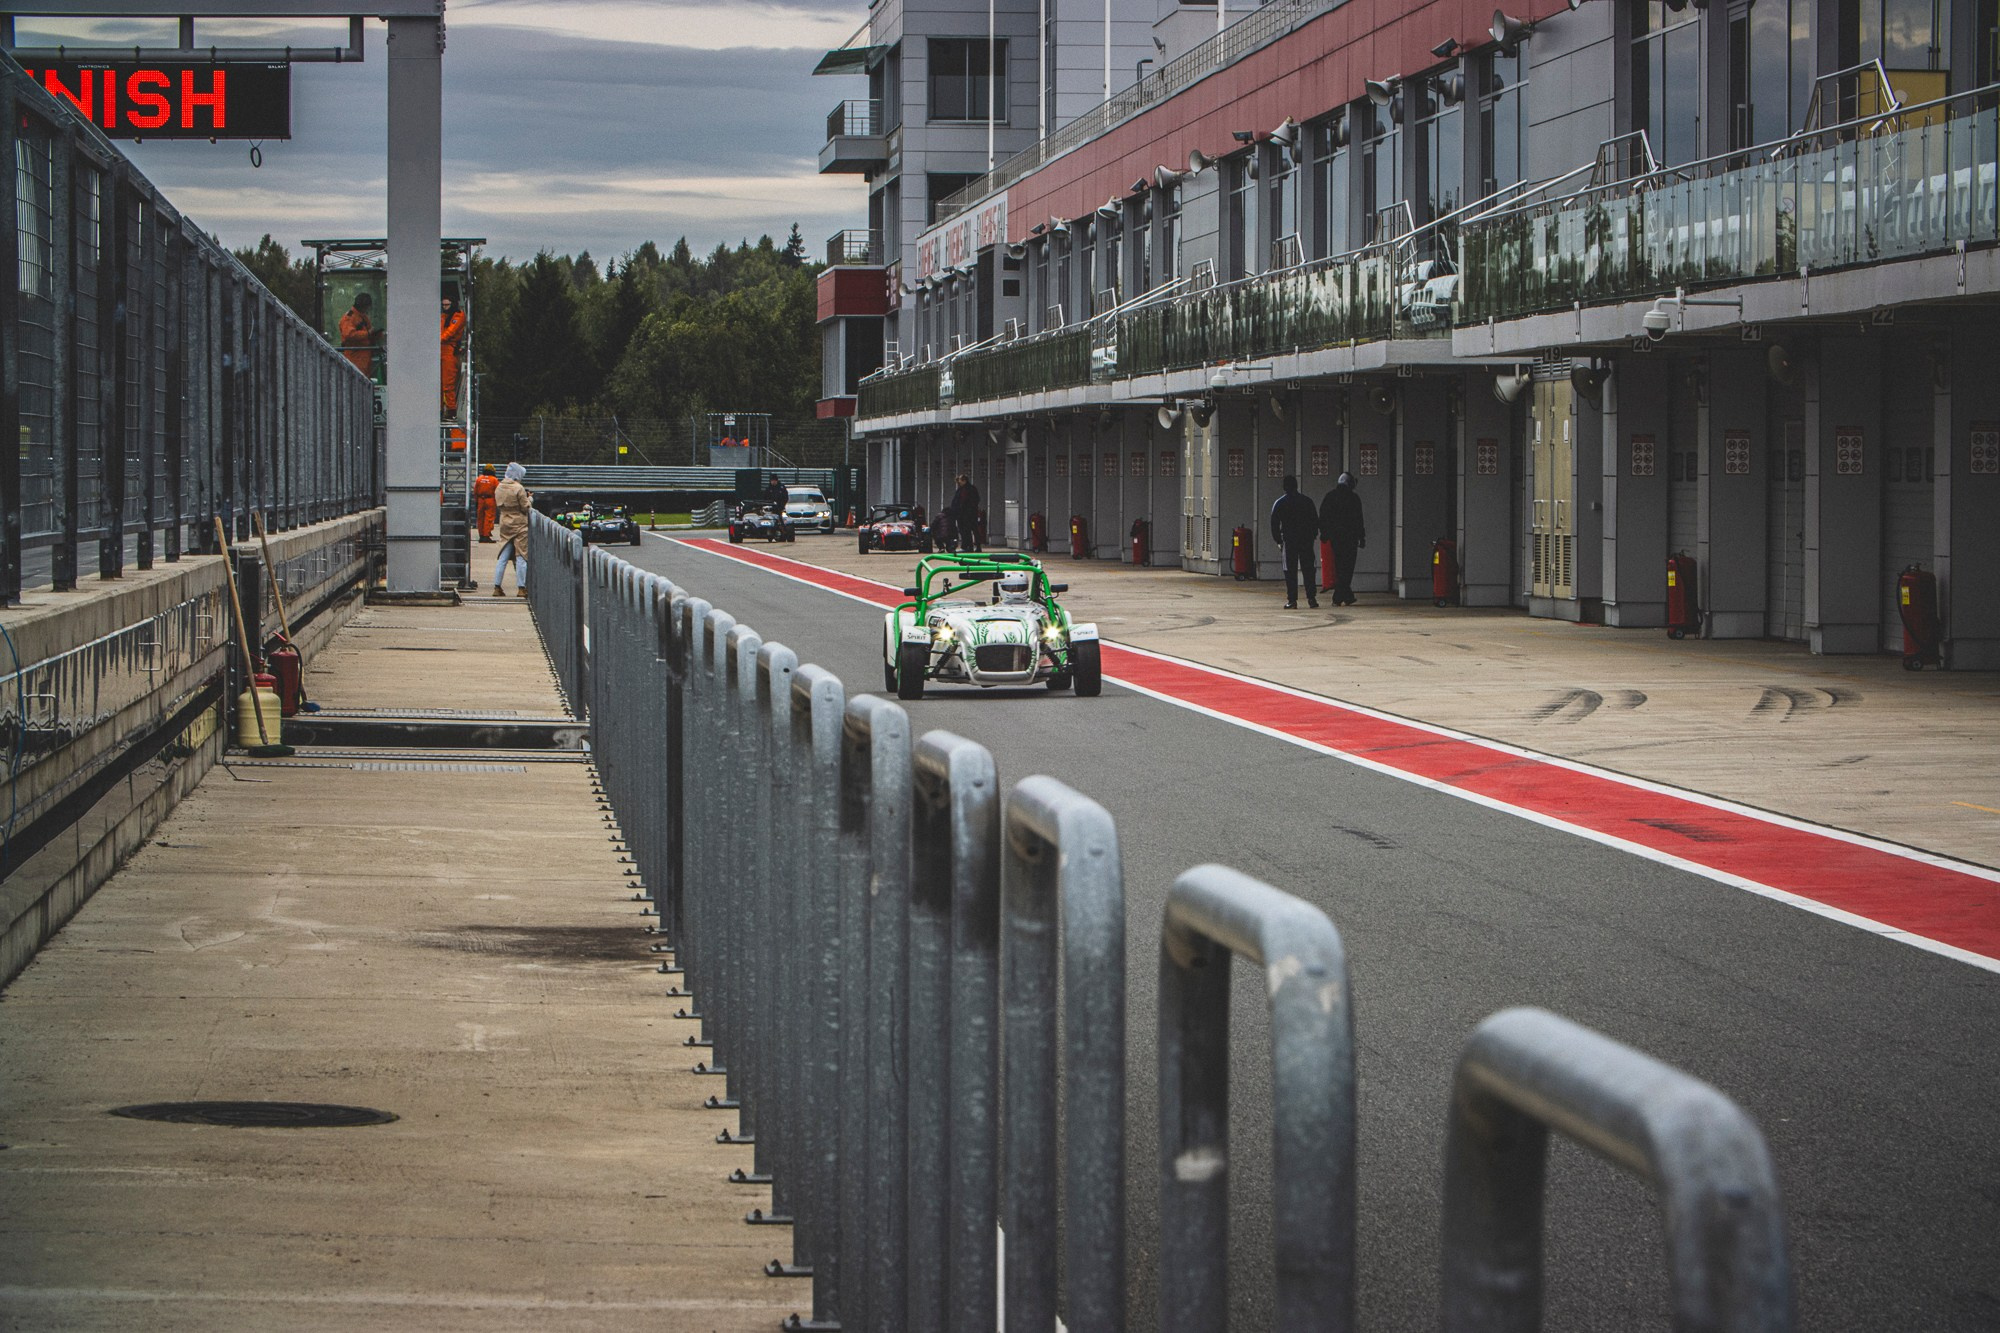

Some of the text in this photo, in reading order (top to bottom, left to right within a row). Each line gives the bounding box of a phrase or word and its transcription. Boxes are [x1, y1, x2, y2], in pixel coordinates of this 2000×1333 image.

[24, 69, 226, 128] NISH
[1874, 309, 1893, 323] 22
[1744, 325, 1760, 339] 21
[1634, 338, 1651, 351] 20
[1545, 346, 1561, 360] 19
[1398, 365, 1412, 376] 18
[1288, 380, 1300, 389] 16
[1340, 373, 1352, 383] 17
[1244, 385, 1254, 393] 15
